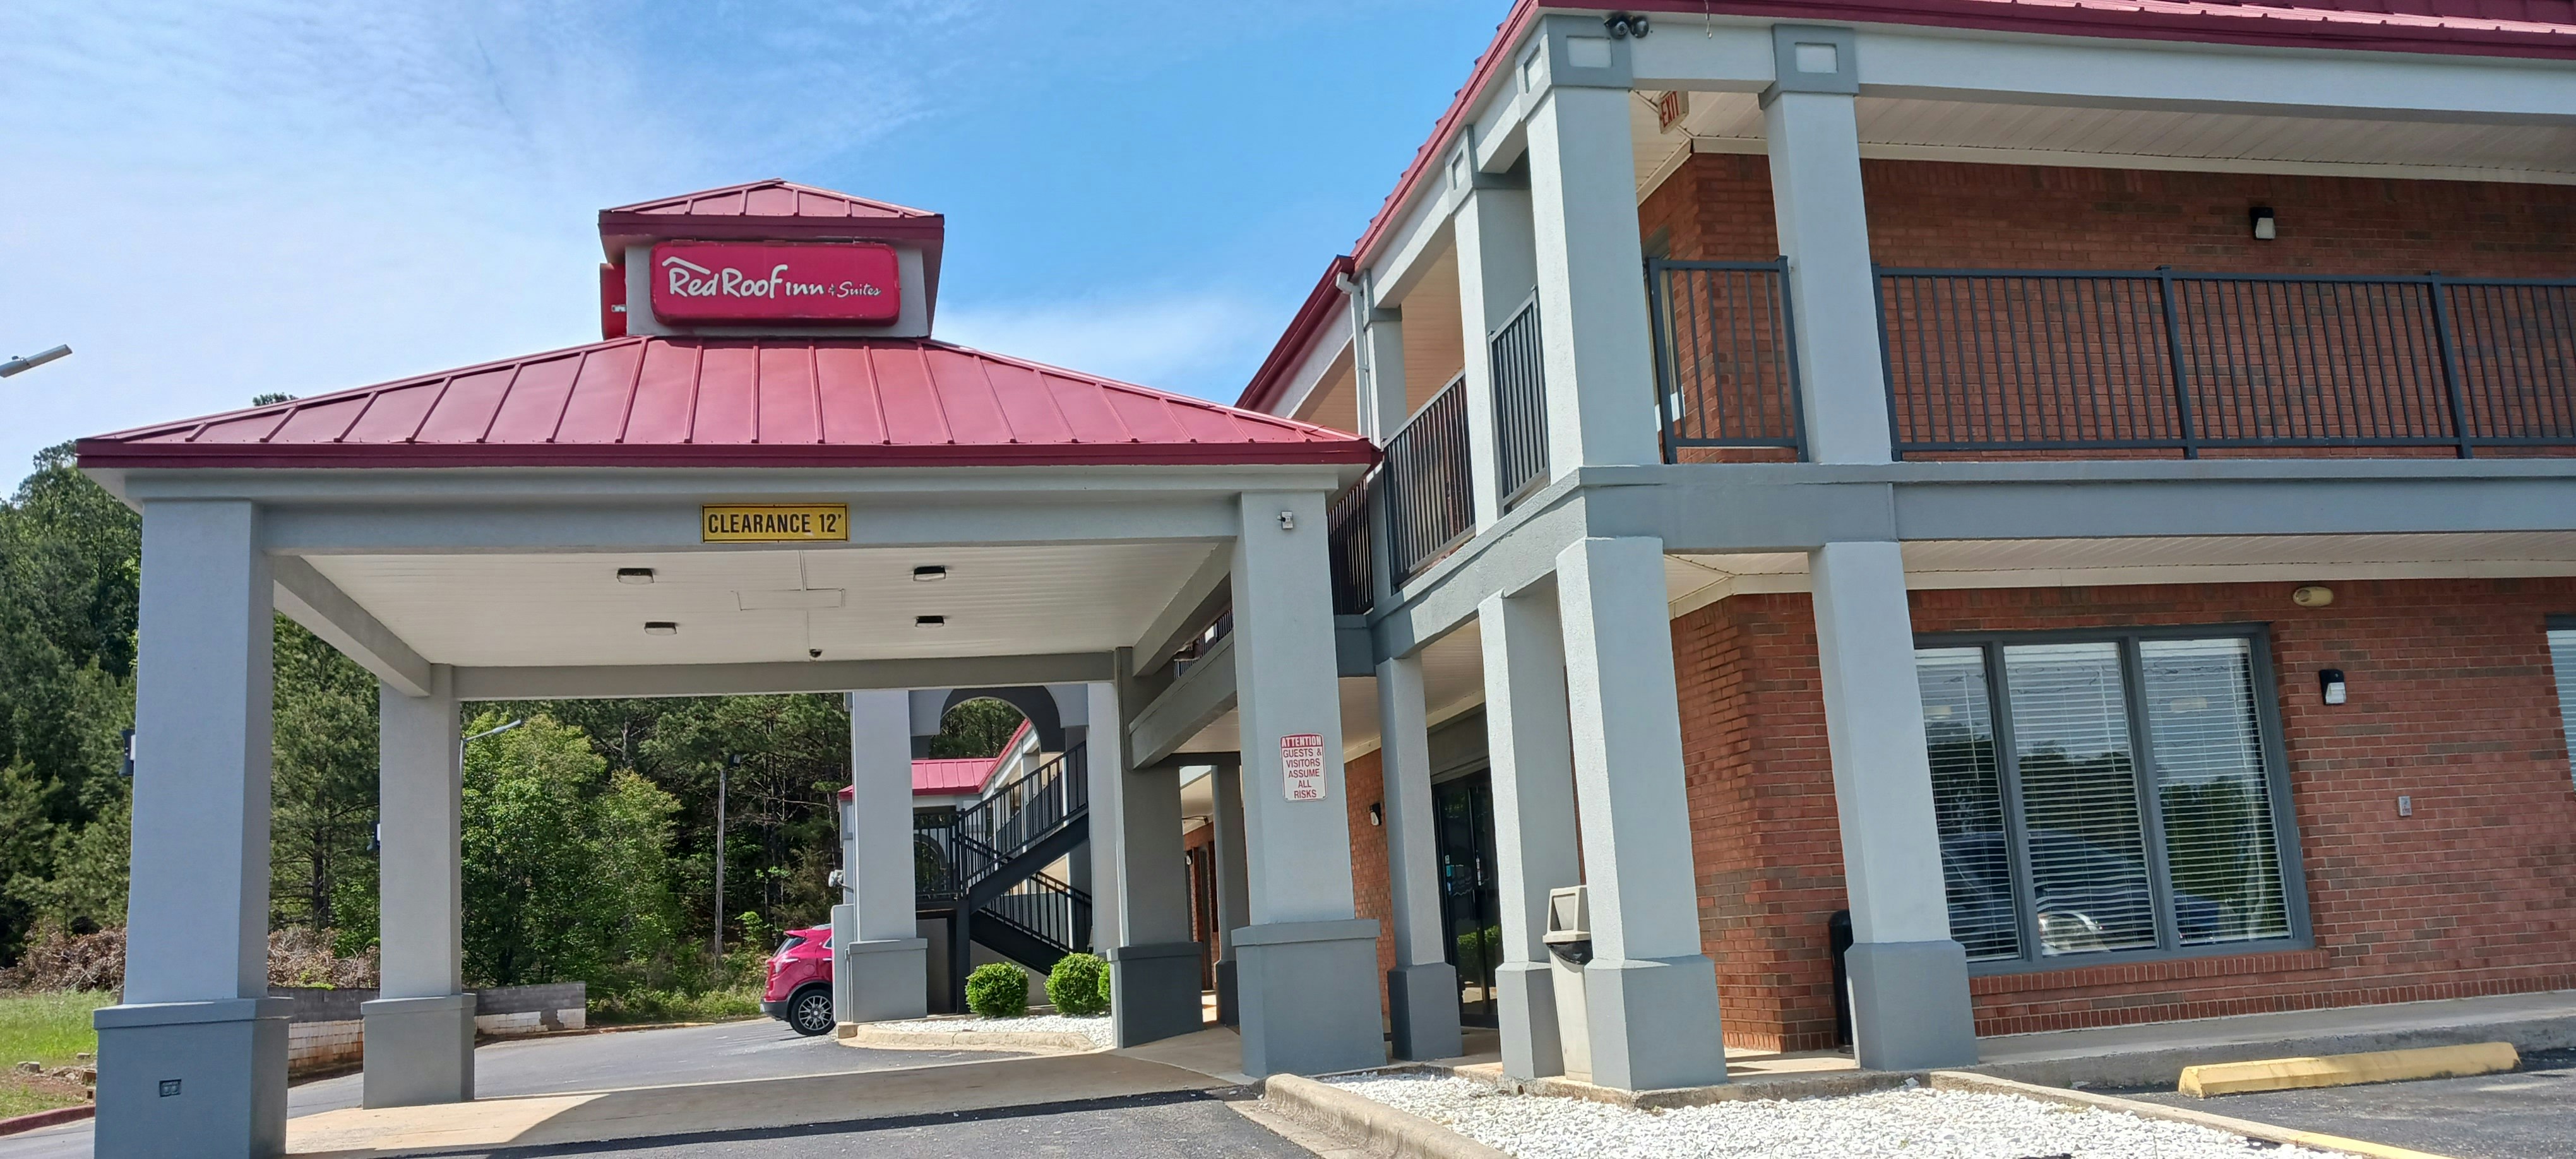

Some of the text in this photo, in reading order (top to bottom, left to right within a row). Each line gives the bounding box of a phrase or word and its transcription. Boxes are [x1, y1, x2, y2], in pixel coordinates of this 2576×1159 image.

[1661, 91, 1679, 128] EXIT
[669, 267, 719, 297] Red
[837, 281, 881, 298] Suites
[708, 513, 842, 533] CLEARANCE 12'
[1282, 735, 1322, 747] ATTENTION
[1283, 747, 1322, 758] GUESTS &
[1286, 758, 1320, 768] VISITORS
[1288, 768, 1320, 778] ASSUME
[1298, 780, 1312, 788] ALL
[1294, 789, 1316, 799] RISKS
